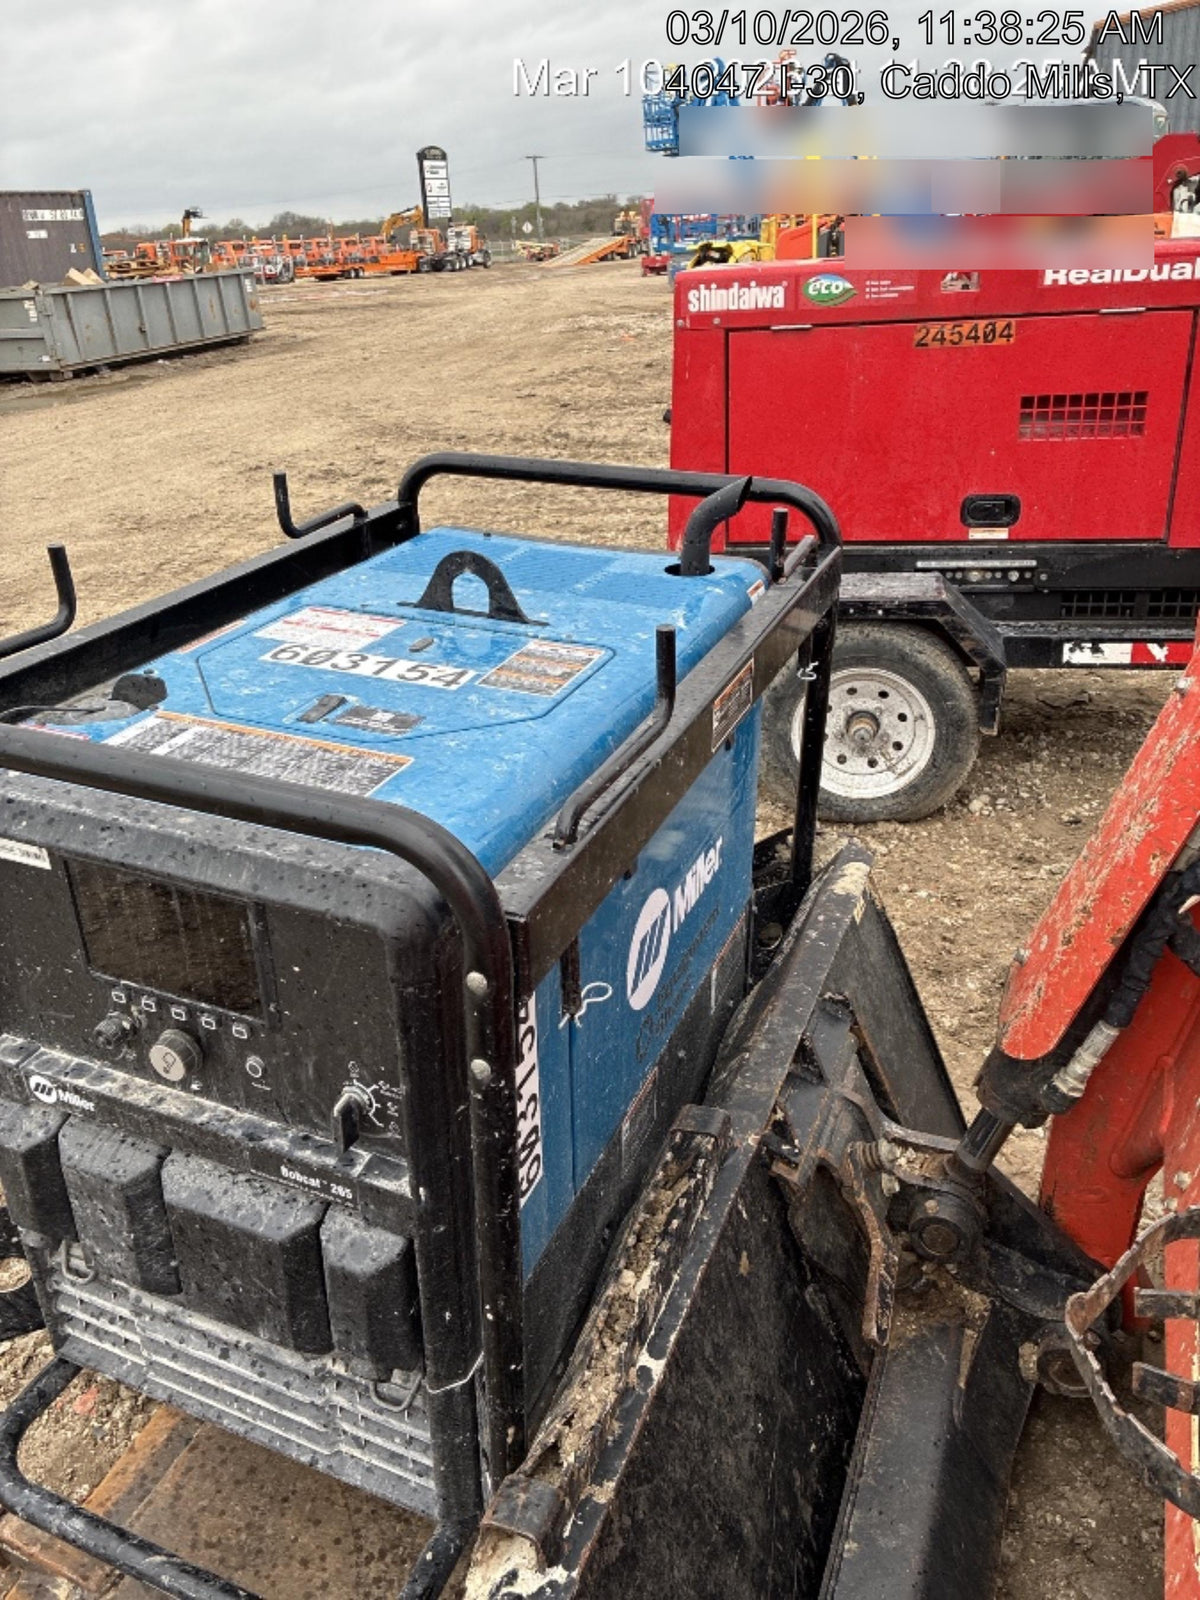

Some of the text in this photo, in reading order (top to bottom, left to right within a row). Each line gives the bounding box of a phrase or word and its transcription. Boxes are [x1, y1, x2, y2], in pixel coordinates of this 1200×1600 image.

[914, 321, 1014, 347] 245404
[269, 644, 469, 687] 603154
[672, 836, 722, 934] Miller
